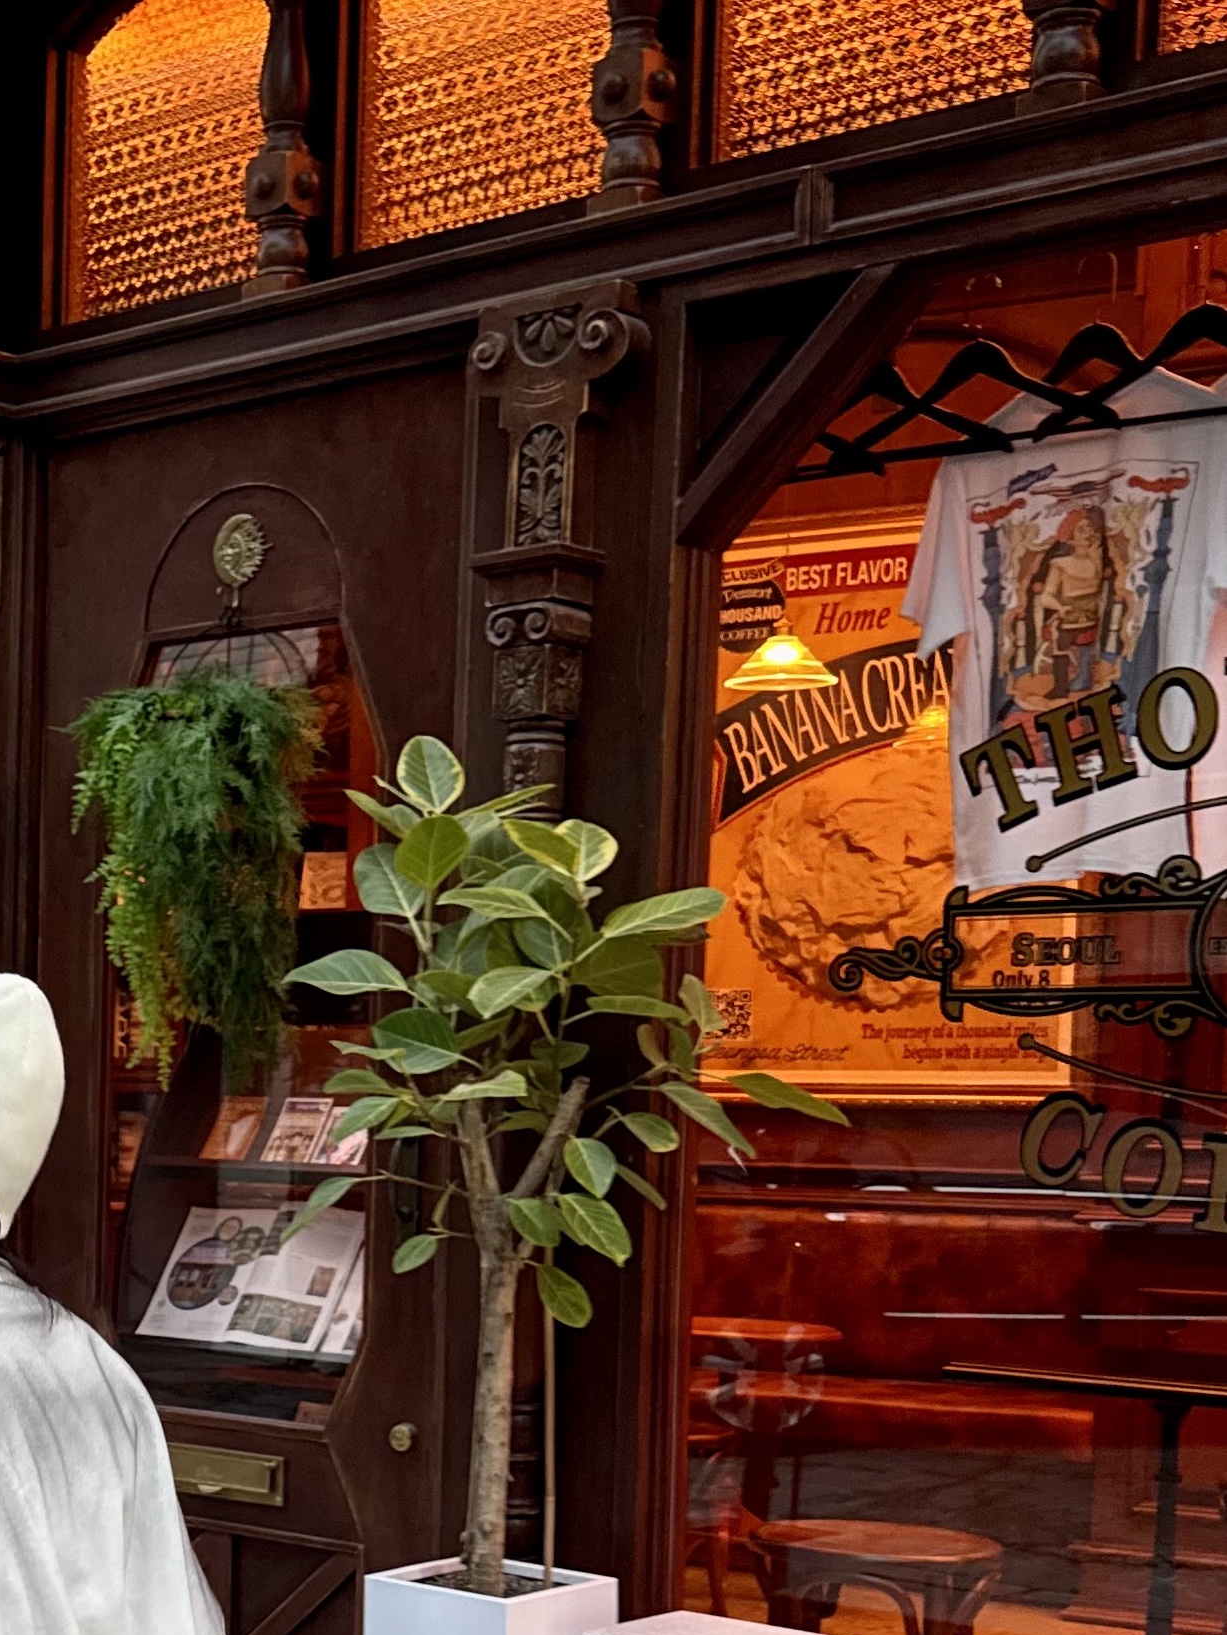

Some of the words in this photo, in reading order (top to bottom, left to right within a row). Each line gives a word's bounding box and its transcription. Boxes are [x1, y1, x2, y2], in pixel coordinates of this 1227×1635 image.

[785, 563, 832, 592] BEST
[835, 557, 909, 587] FLAVOR
[813, 602, 891, 635] Home
[724, 669, 868, 794] BANANA
[862, 648, 955, 734] CREA
[1010, 931, 1122, 967] SEOUL
[992, 969, 1034, 988] Only
[861, 1023, 884, 1039] The
[955, 1022, 1012, 1038] thousand
